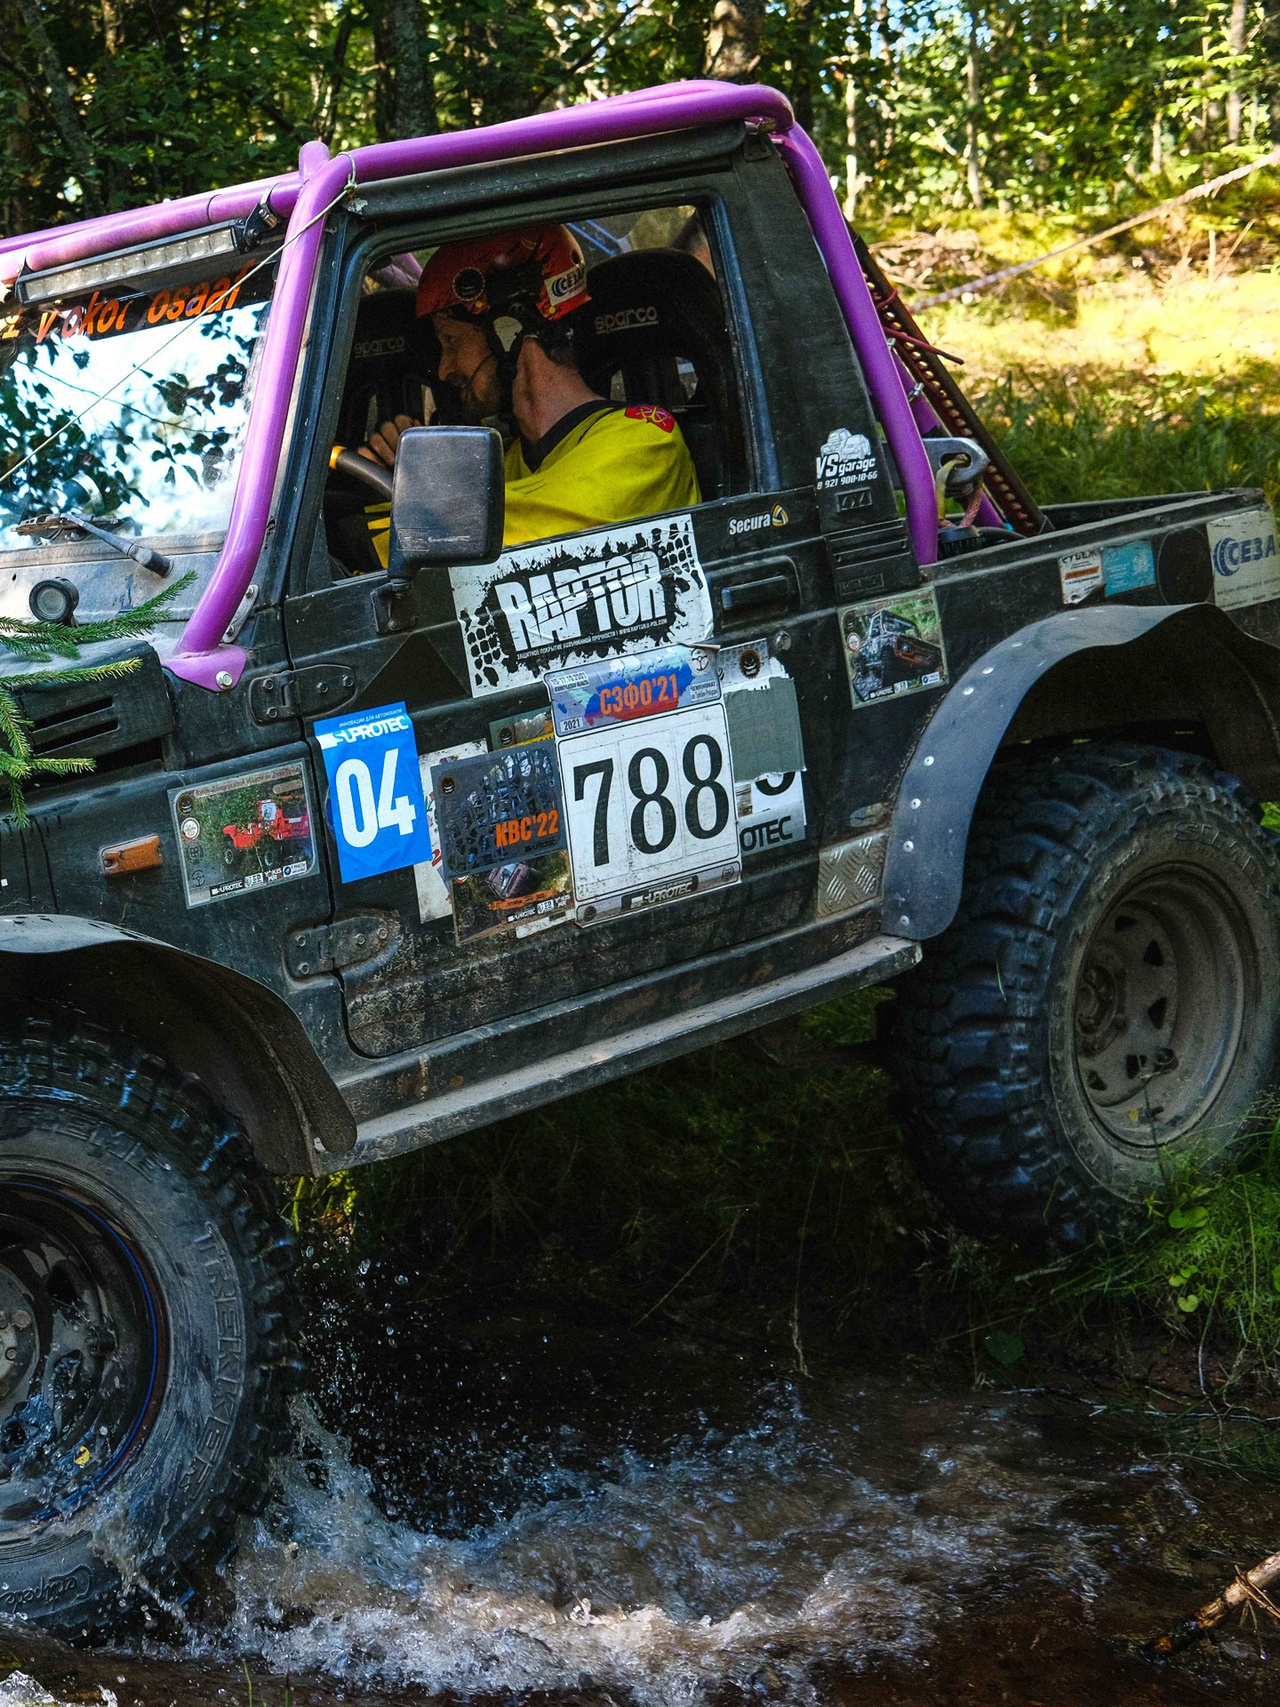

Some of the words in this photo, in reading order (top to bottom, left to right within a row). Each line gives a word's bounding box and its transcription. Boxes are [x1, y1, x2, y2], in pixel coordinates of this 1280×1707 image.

[595, 305, 659, 334] sparco
[354, 335, 406, 359] sparco
[728, 511, 771, 536] Secura
[494, 550, 668, 652] RAPTOR
[563, 719, 581, 731] 2021
[335, 748, 417, 848] 04
[573, 734, 730, 867] 788
